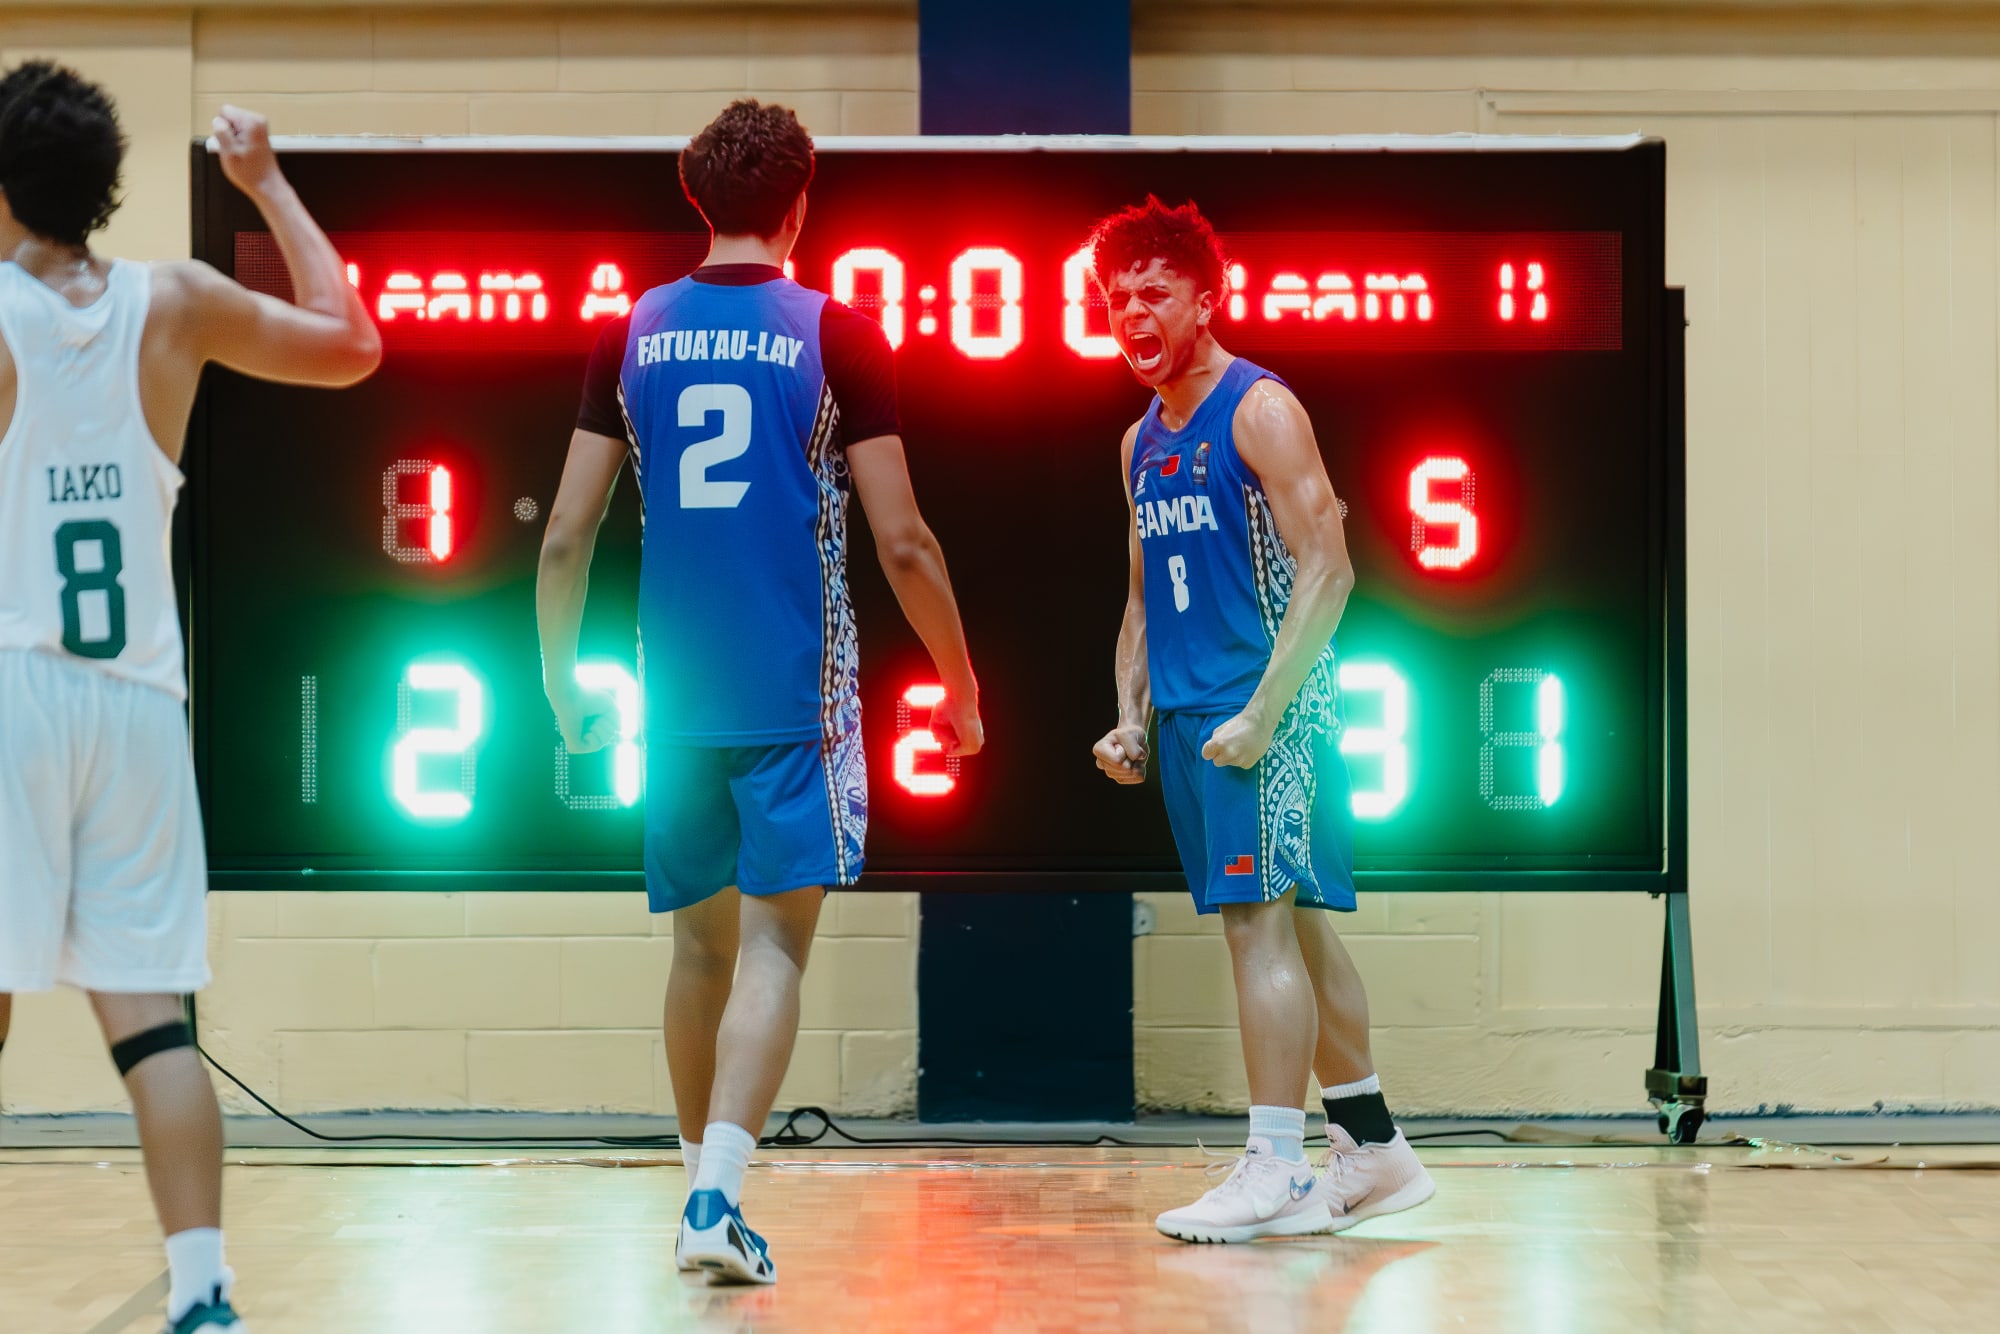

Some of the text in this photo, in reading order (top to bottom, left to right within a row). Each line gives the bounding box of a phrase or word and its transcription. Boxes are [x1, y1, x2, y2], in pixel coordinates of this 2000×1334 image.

[347, 263, 546, 321] eam
[637, 329, 804, 368] FATUA'AU-LAY
[678, 384, 752, 508] 2
[47, 463, 122, 502] IAKO
[1136, 495, 1219, 540] SAMOA
[1409, 456, 1478, 571] 5
[55, 520, 126, 659] 8
[1168, 554, 1190, 613] 8
